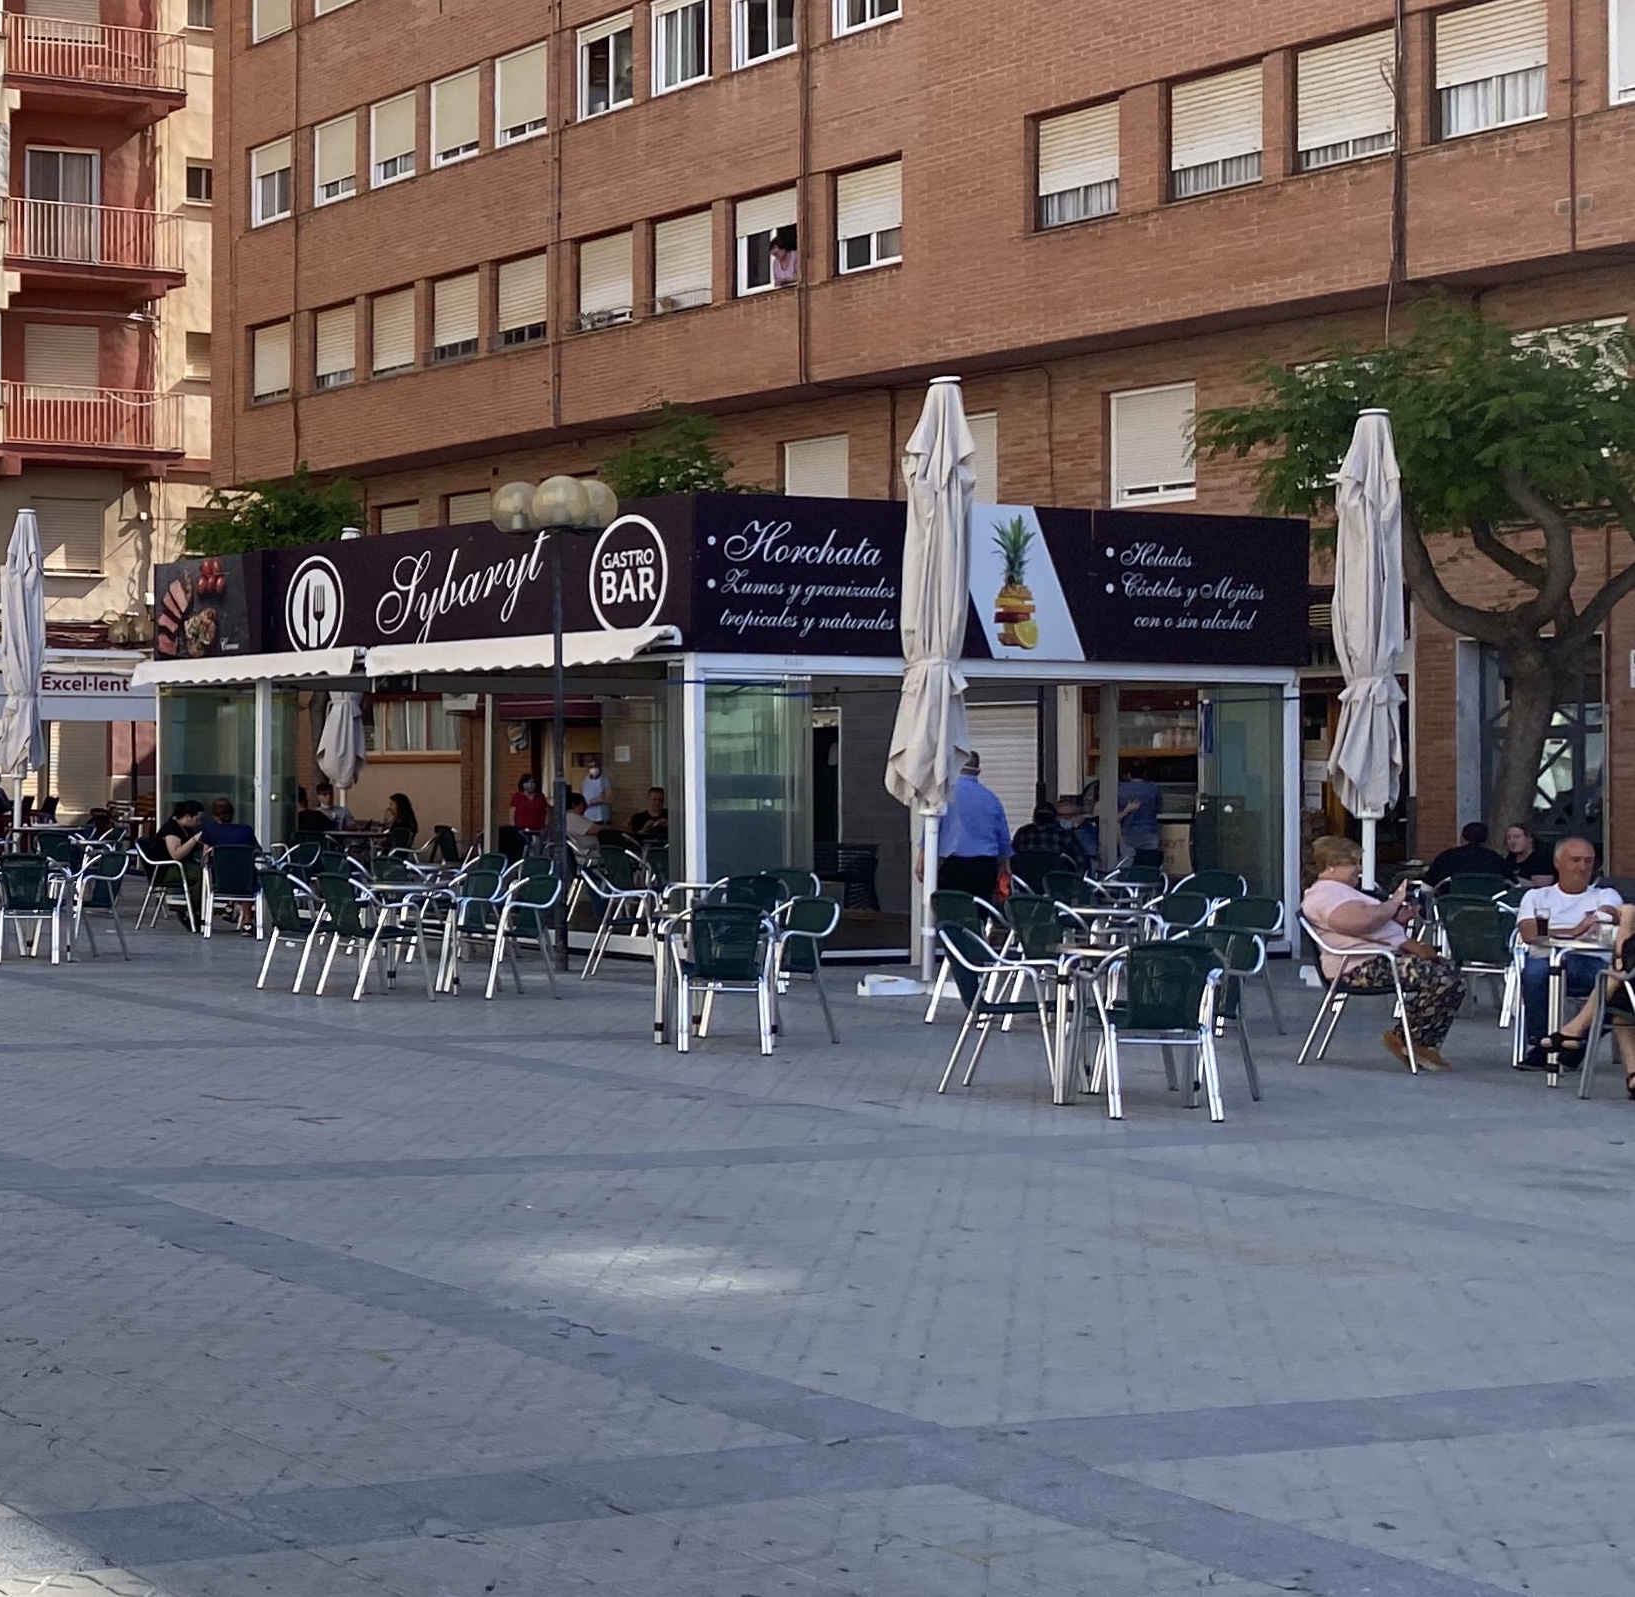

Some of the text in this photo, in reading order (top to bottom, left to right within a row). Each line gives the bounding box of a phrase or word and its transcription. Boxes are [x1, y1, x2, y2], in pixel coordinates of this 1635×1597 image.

[602, 548, 654, 570] GASTRO
[724, 520, 882, 566] Horchata
[1120, 542, 1192, 568] Helados
[375, 530, 550, 644] Sybaryt
[601, 567, 656, 604] BAR
[721, 568, 896, 605] Zumos y granizados
[1121, 571, 1182, 599] Cócteles
[1183, 587, 1198, 608] y
[720, 606, 895, 638] tropicales y naturales
[1134, 615, 1161, 628] con
[1176, 611, 1198, 629] sin
[1201, 608, 1257, 630] alcohol
